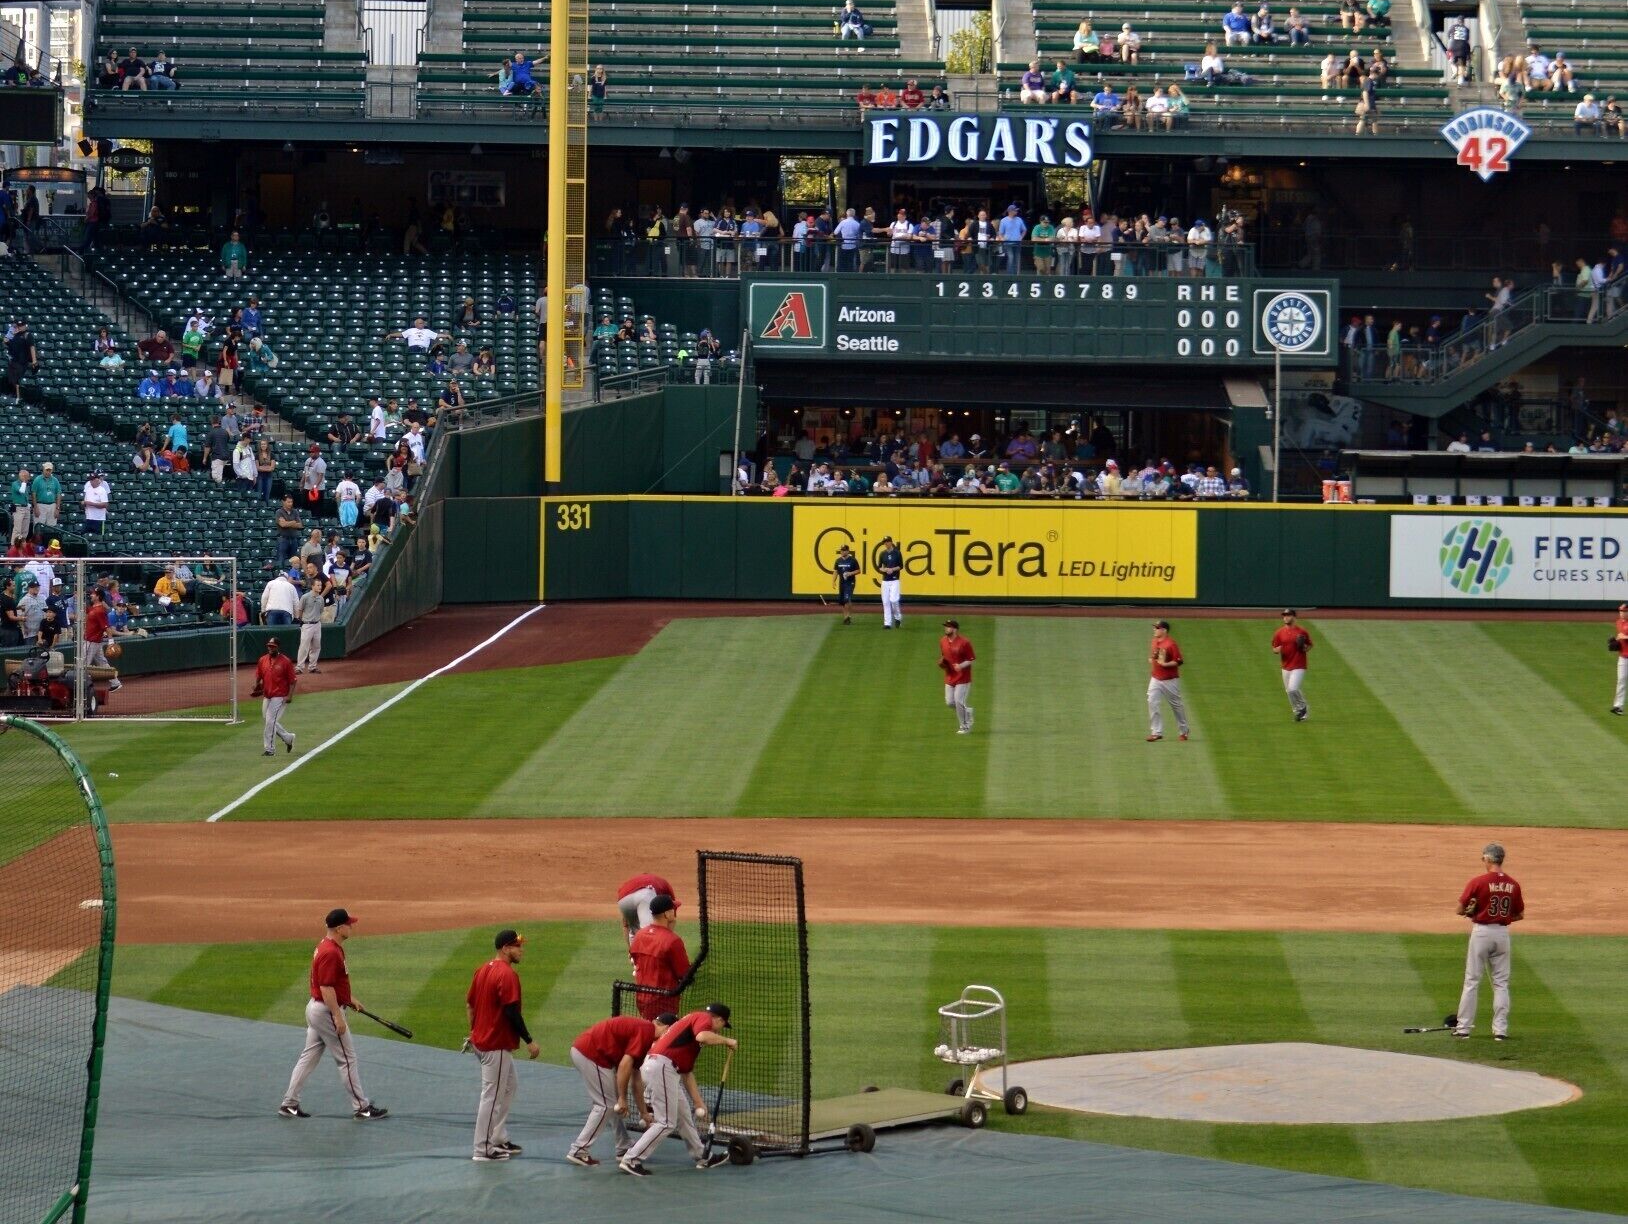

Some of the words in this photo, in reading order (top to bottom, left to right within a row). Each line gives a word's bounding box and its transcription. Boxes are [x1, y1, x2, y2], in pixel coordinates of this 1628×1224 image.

[1447, 114, 1525, 141] ROBINSON
[869, 116, 1092, 167] EDGAR'S
[134, 156, 152, 165] 150
[1459, 137, 1508, 171] 42
[936, 282, 945, 297] 1
[958, 282, 969, 297] 2
[982, 282, 993, 297] 3
[1007, 283, 1019, 297] 4
[1030, 283, 1041, 298] 5
[1053, 284, 1065, 299] 6
[1078, 284, 1090, 299] 7
[1101, 284, 1113, 299] 8
[1126, 284, 1138, 300] 9
[1177, 285, 1192, 301] R
[1201, 285, 1215, 301] H
[1225, 285, 1239, 301] E
[838, 306, 896, 323] Arizona
[1177, 310, 1191, 328] 0
[1201, 310, 1215, 328] 0
[1225, 311, 1239, 328] 0
[1270, 298, 1313, 317] SEATTLE
[836, 334, 899, 352] Seattle
[1177, 338, 1191, 356] 0
[1201, 338, 1215, 356] 0
[1225, 338, 1239, 356] 0
[1270, 325, 1313, 345] MARINERS
[557, 503, 591, 530] 331
[1534, 536, 1620, 560] FRED
[1058, 561, 1096, 577] LED
[1100, 561, 1176, 581] Lighting
[1533, 569, 1589, 582] CURES
[1596, 569, 1628, 582] STA
[1488, 882, 1514, 893] McKAY
[1488, 895, 1511, 918] 39
